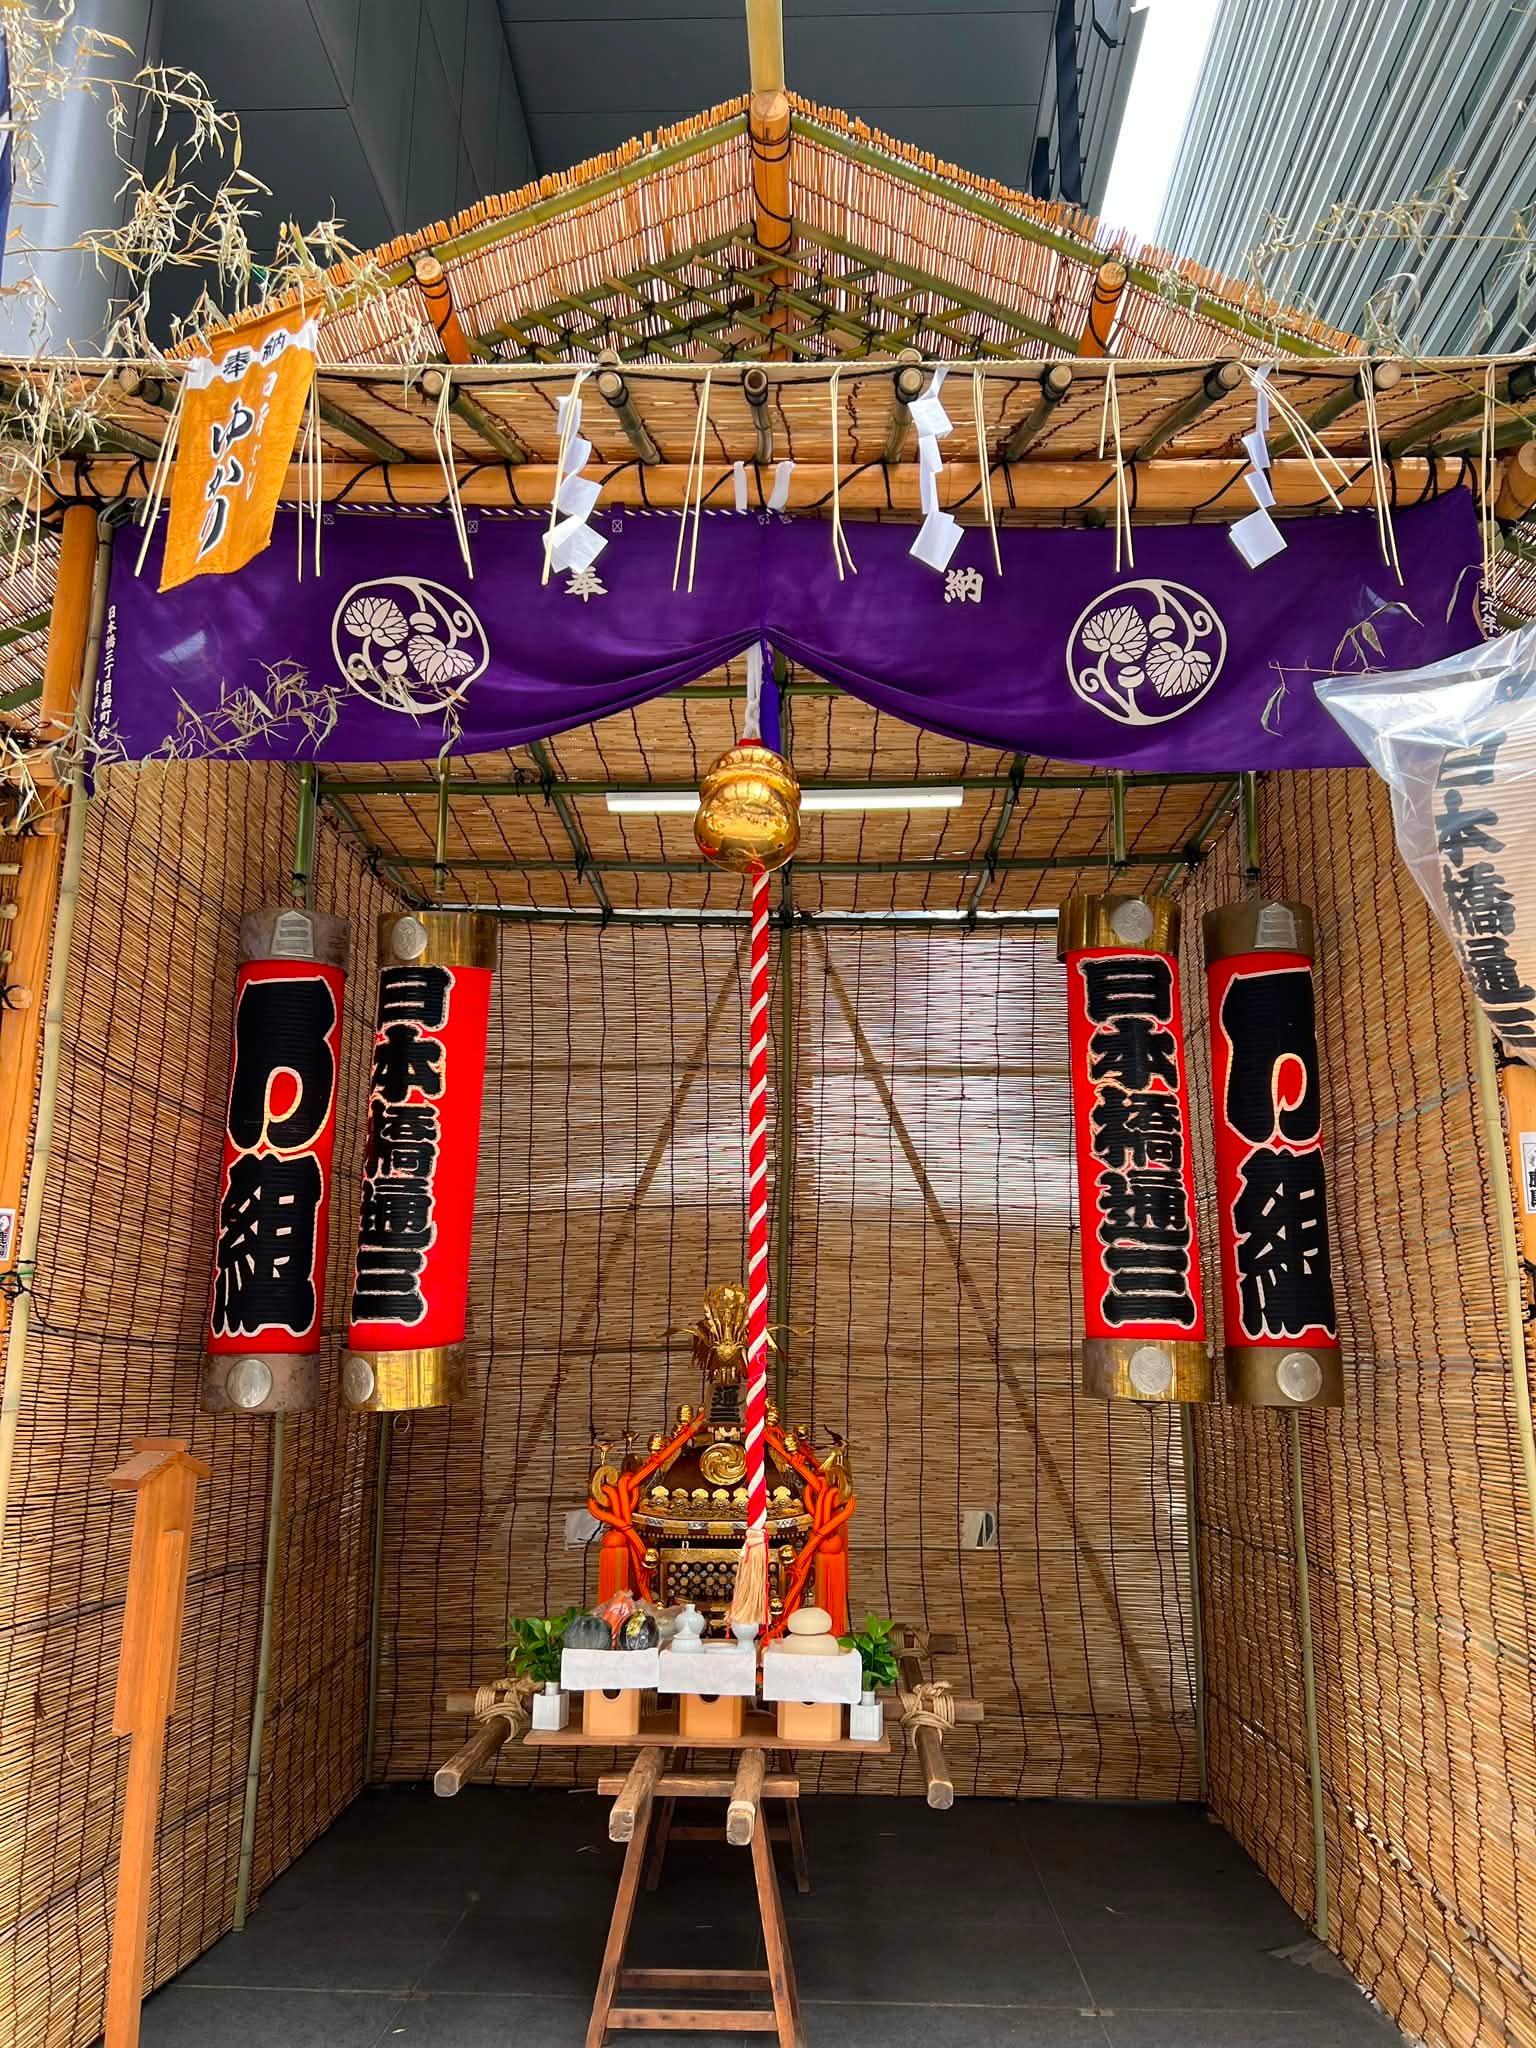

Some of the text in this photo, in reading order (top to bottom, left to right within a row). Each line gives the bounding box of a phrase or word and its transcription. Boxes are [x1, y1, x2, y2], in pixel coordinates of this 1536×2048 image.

[222, 331, 287, 378] 奉納
[195, 396, 254, 563] ゆかり
[944, 566, 984, 604] 納
[350, 964, 456, 1328] 日本橋通三
[1075, 954, 1198, 1330] 日本橋通三
